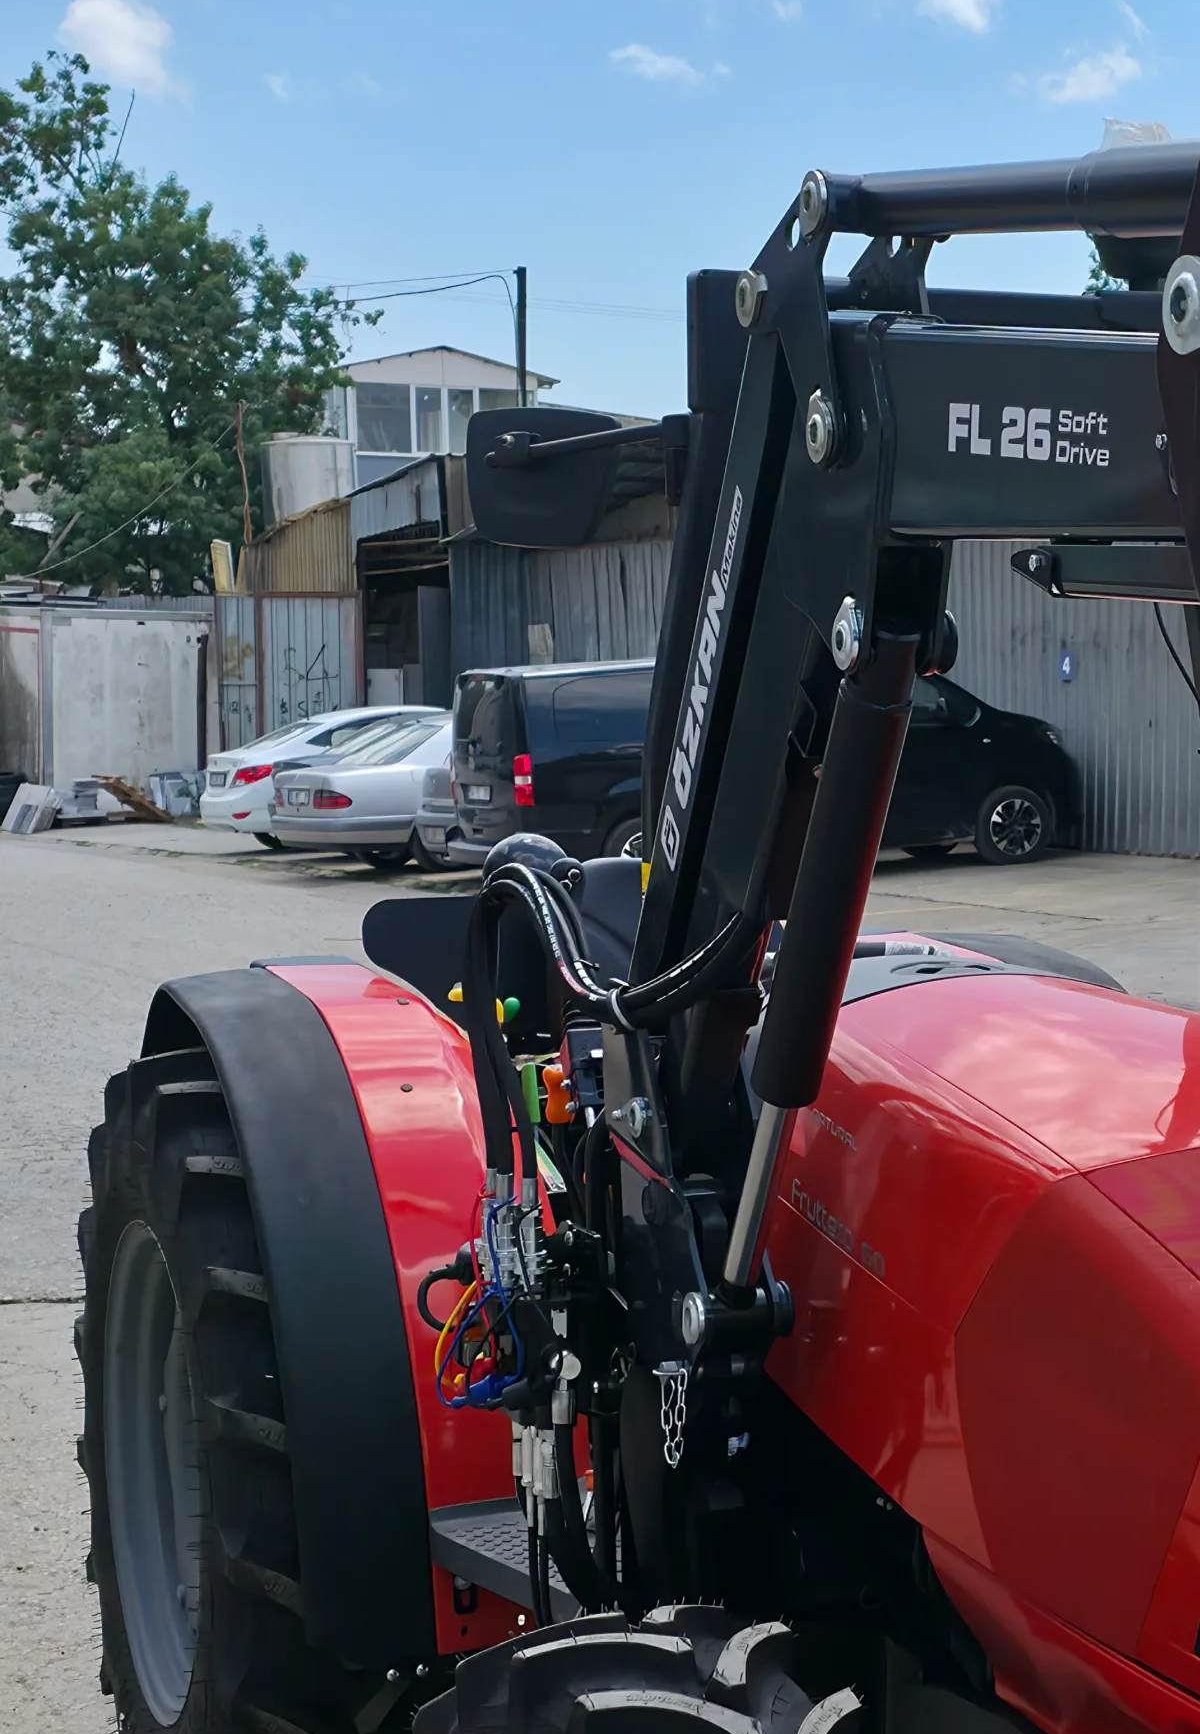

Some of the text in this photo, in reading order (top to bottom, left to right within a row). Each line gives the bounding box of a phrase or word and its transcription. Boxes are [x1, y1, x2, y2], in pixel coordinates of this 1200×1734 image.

[948, 402, 1051, 461] FL 26
[1057, 409, 1108, 435] Soft
[1055, 440, 1109, 466] Drive
[1062, 656, 1070, 675] 4
